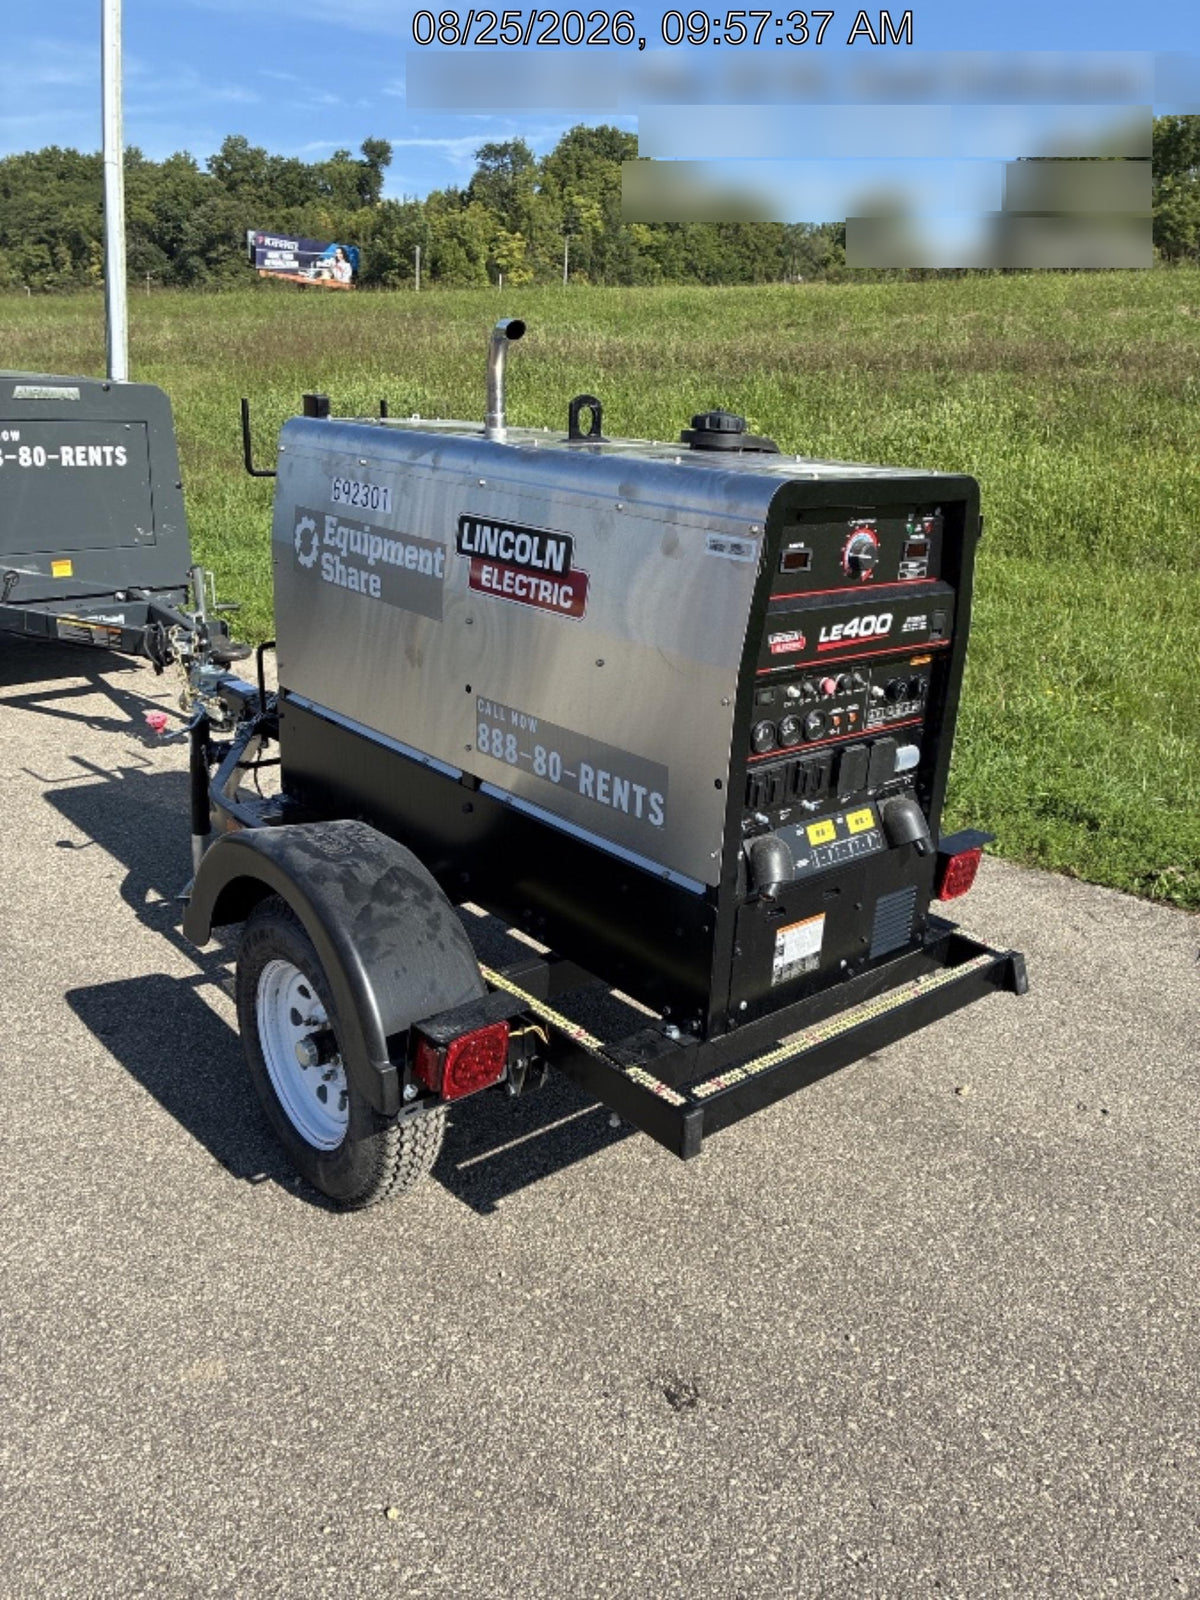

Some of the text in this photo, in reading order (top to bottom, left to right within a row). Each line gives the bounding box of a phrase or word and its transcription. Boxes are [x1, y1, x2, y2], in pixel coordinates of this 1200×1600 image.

[332, 478, 389, 511] 692301
[323, 515, 445, 579] Equipment
[460, 521, 567, 573] LINCOLN
[320, 552, 382, 599] Share
[480, 564, 574, 610] ELECTRIC
[818, 612, 894, 643] LE400
[477, 698, 539, 734] CALL NOW
[477, 722, 665, 827] 888-80-RENTS
